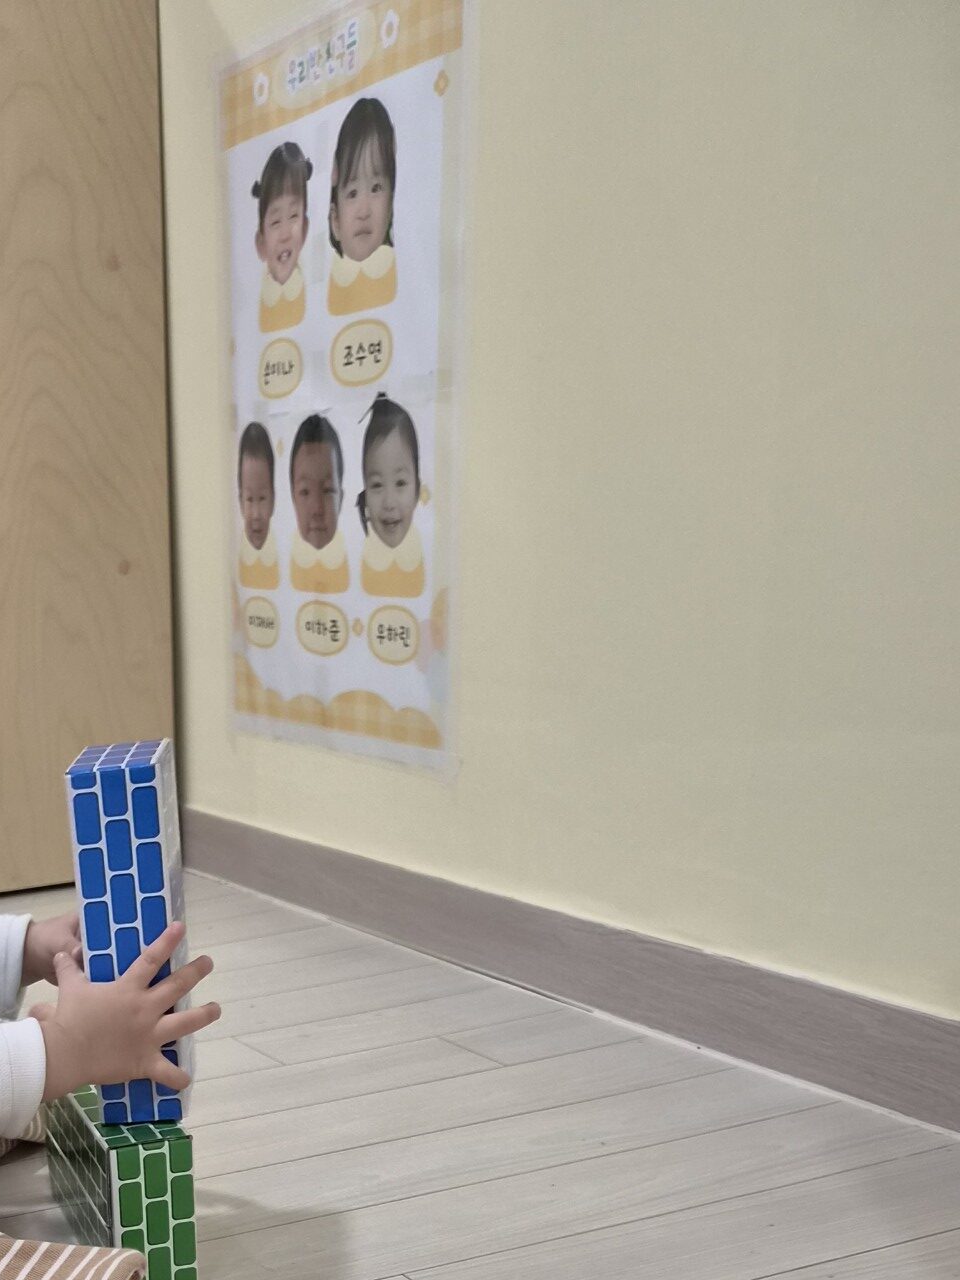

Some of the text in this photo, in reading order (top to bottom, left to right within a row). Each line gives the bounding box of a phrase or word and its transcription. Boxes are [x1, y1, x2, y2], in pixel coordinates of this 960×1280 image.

[342, 340, 382, 367] 조수연
[304, 618, 341, 642] 이하준
[376, 624, 410, 648] 우하린
